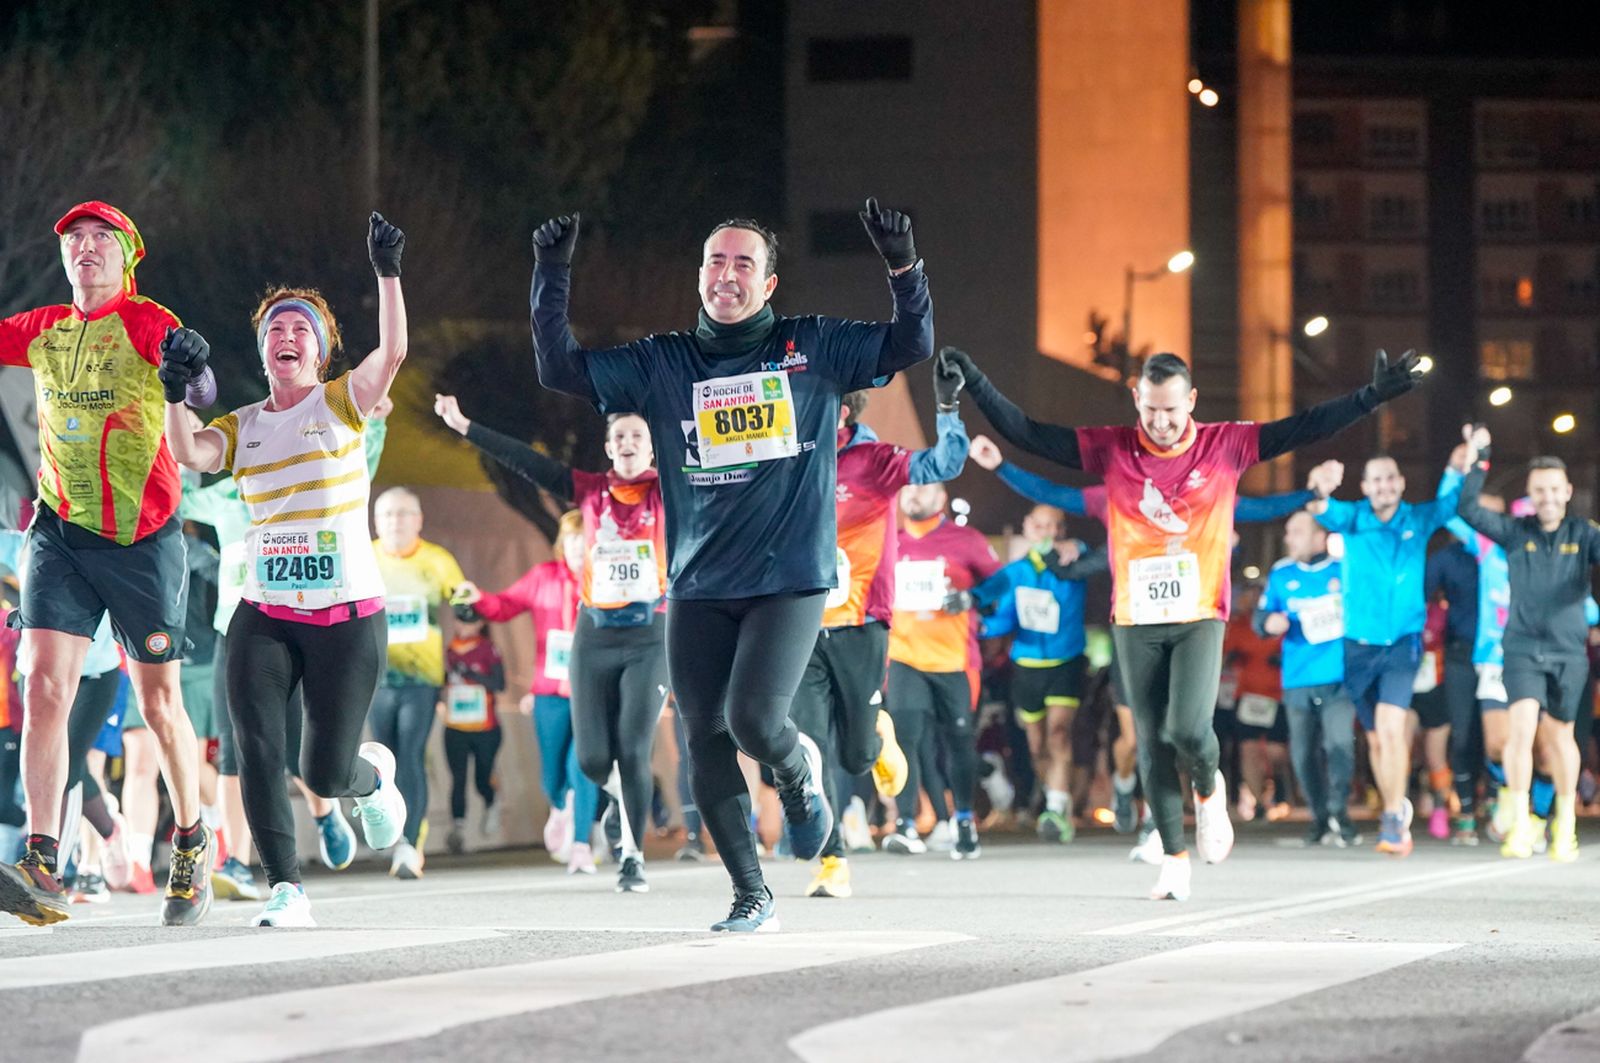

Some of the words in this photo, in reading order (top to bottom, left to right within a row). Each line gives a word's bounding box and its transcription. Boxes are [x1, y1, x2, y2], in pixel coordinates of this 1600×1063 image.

[712, 386, 741, 397] NOCHE
[743, 384, 754, 393] DE
[89, 402, 114, 410] Motor
[703, 399, 722, 410] SAN
[714, 403, 775, 435] 8037
[725, 434, 745, 442] ANGEL
[271, 535, 297, 544] NOCHE
[298, 534, 309, 543] DE
[262, 546, 279, 556] SAN
[263, 555, 335, 582] 12469
[608, 563, 640, 581] 296
[1148, 580, 1181, 600] 520
